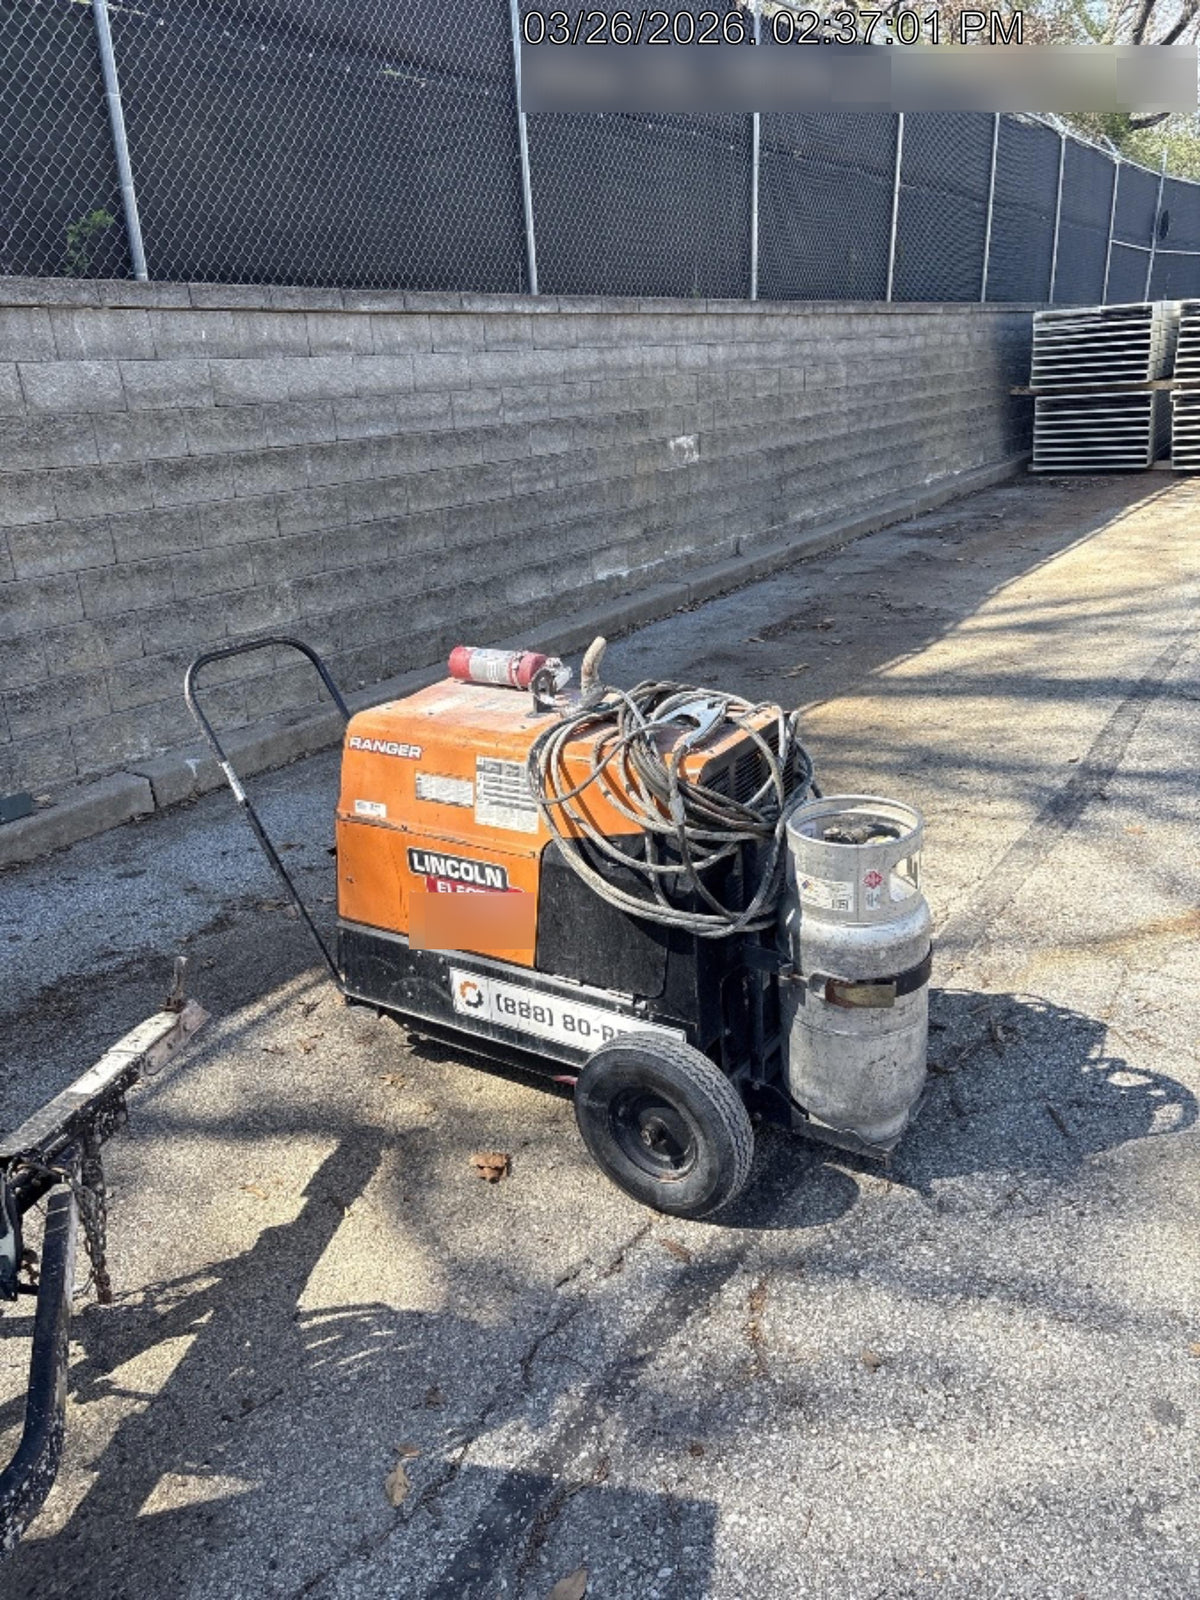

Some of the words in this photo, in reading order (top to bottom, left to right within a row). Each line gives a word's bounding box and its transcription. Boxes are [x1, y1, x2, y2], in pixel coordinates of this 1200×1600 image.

[349, 736, 422, 760] RANGER
[412, 852, 502, 889] LINCOLN
[496, 993, 554, 1027] (888)
